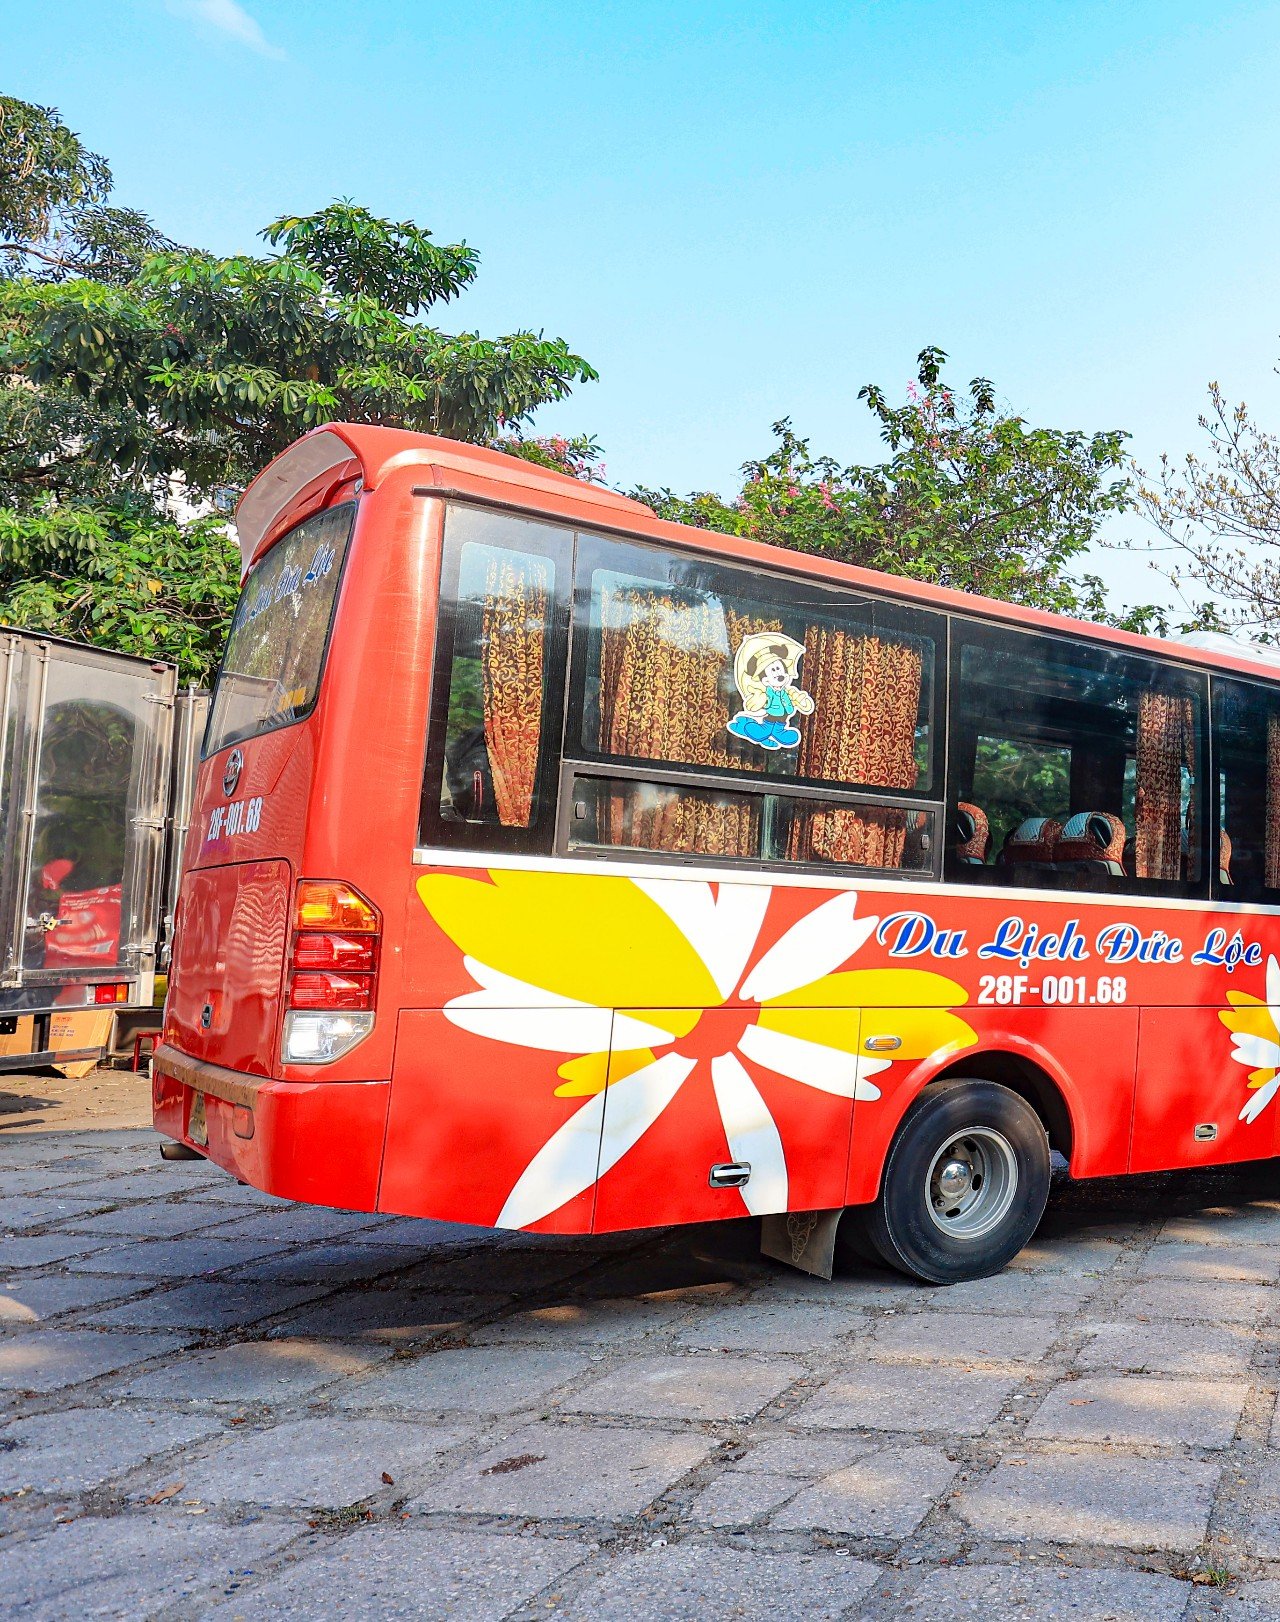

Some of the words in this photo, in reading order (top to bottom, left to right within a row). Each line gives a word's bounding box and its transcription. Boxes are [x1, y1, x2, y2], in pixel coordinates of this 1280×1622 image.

[207, 796, 263, 842] 28F-001.68
[877, 911, 968, 957] Du
[978, 916, 1090, 969] Lịch
[1096, 922, 1184, 963] Đức
[1191, 927, 1263, 973] Lộc
[978, 975, 1127, 1004] 28F-001.68
